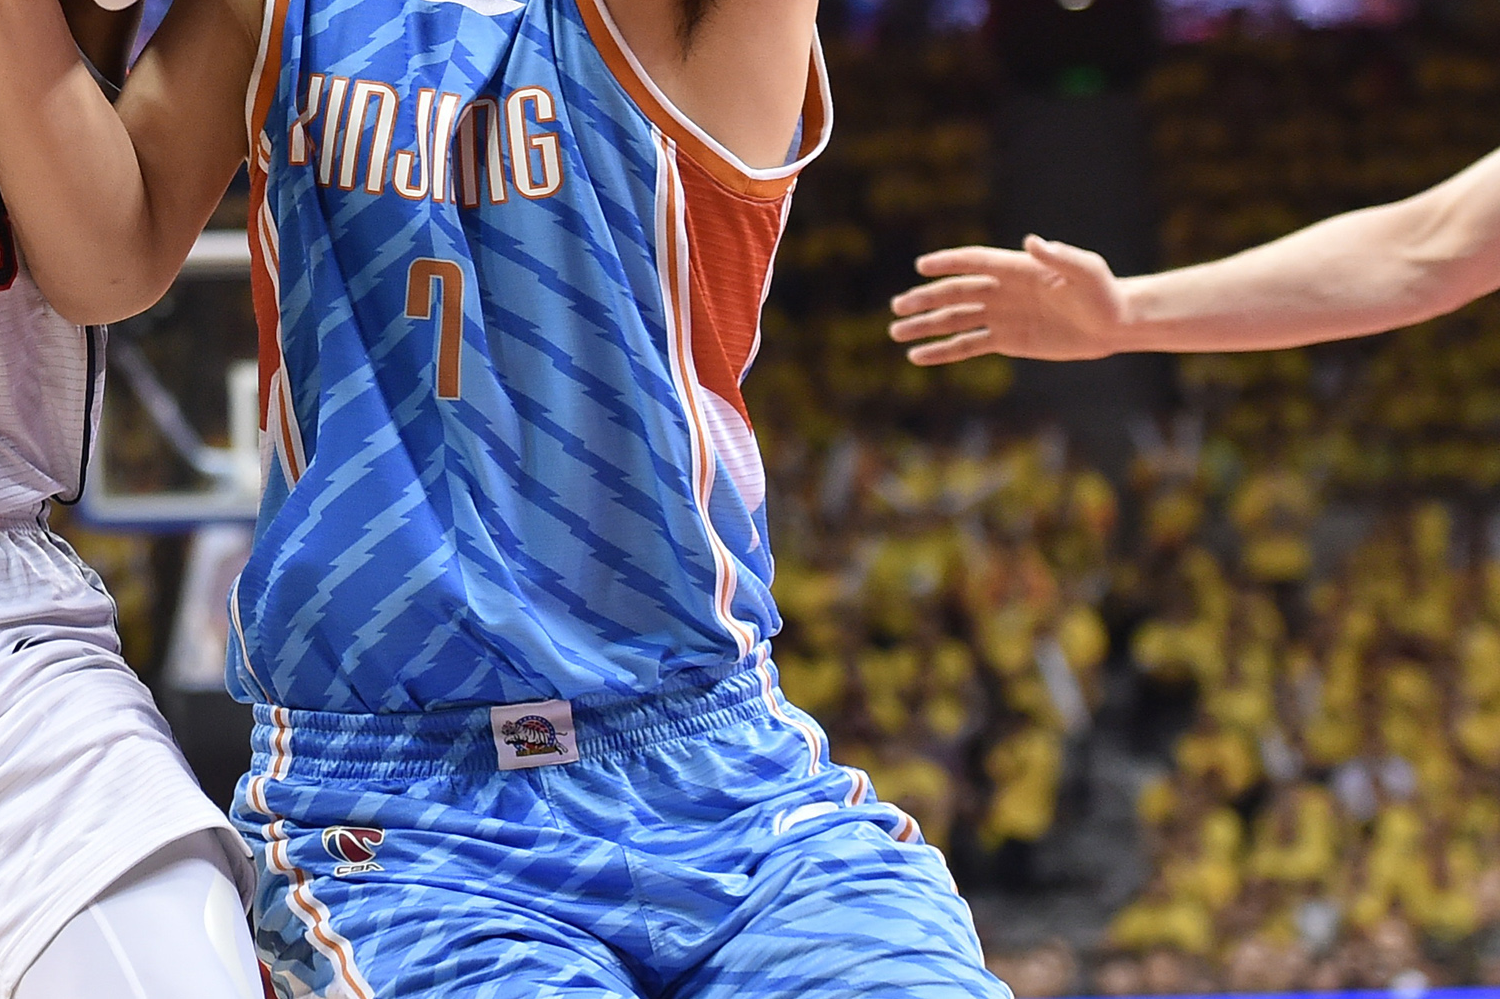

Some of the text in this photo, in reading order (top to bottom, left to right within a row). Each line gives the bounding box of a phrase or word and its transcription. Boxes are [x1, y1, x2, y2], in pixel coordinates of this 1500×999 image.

[287, 72, 565, 209] XINJING
[403, 256, 466, 401] 7
[334, 862, 386, 878] CBA
